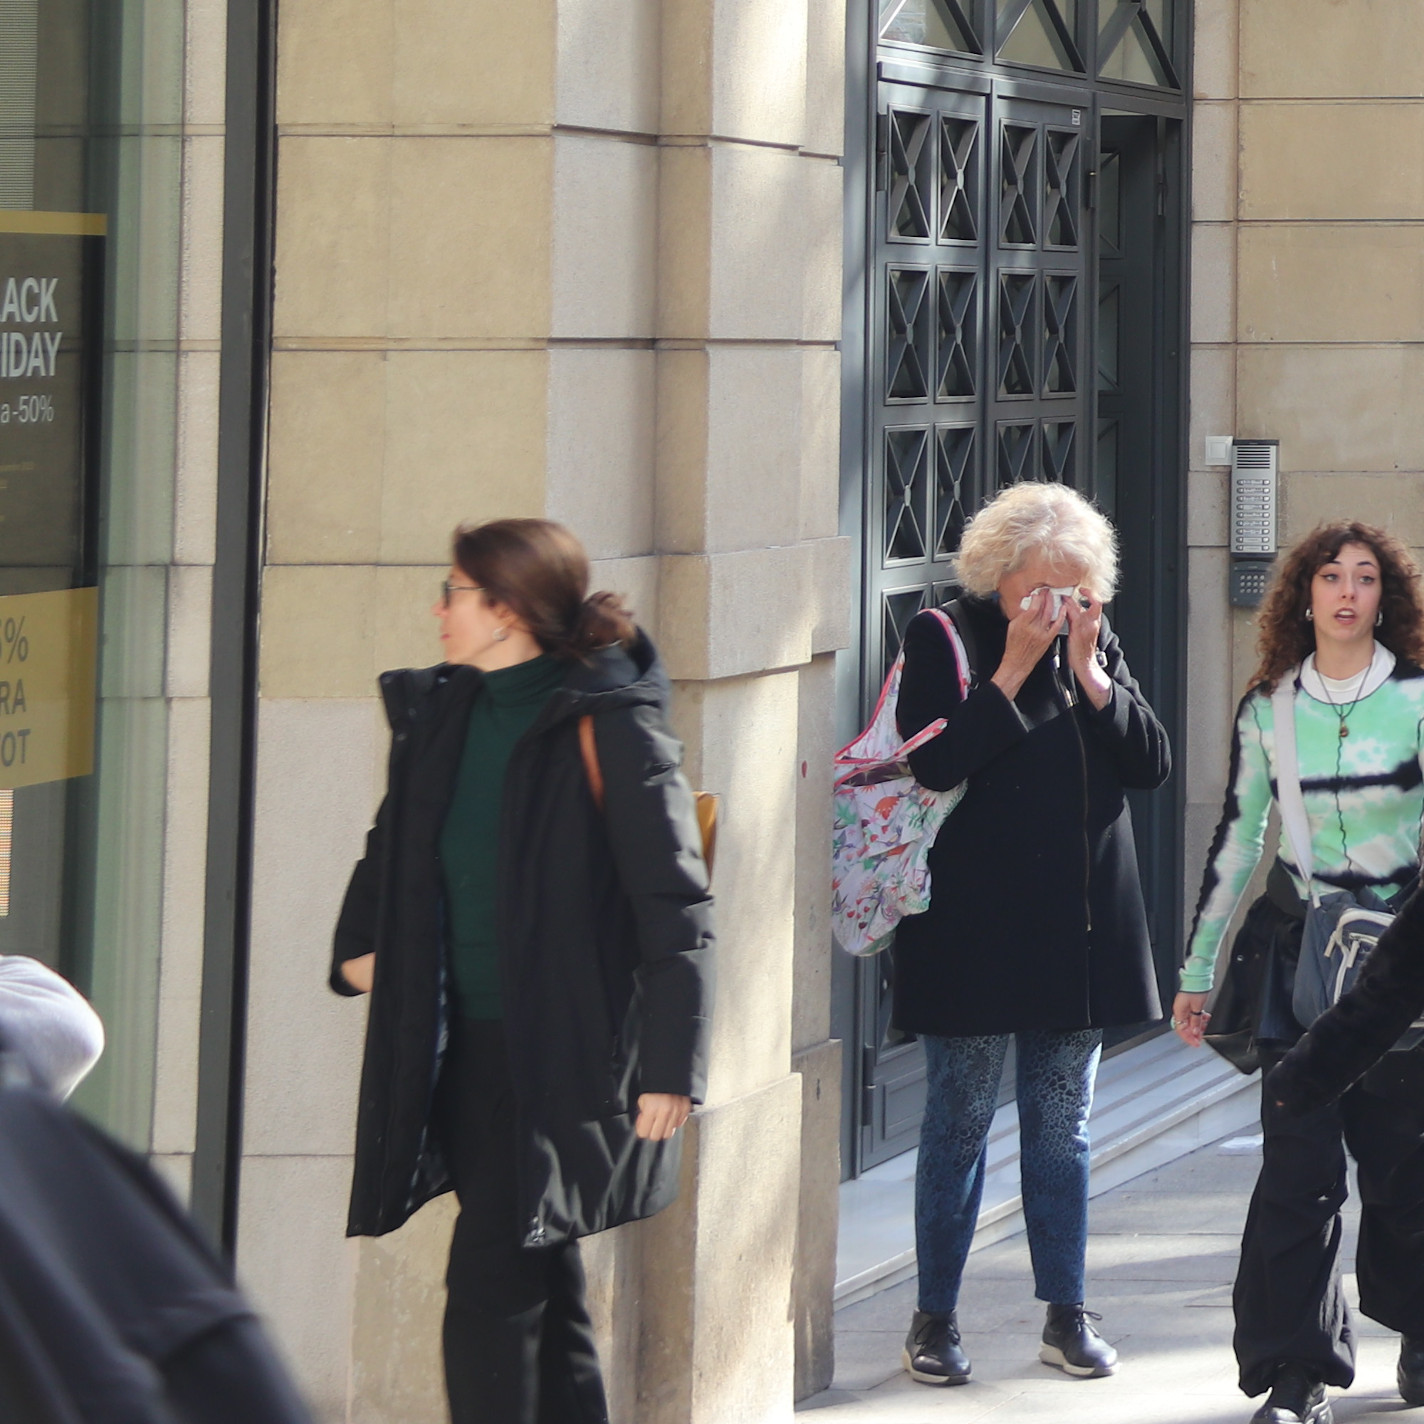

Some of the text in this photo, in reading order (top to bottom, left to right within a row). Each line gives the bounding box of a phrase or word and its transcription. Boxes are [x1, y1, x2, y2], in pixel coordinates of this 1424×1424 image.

[0, 277, 59, 323] ACK
[12, 394, 55, 423] -50%
[0, 728, 32, 768] OT
